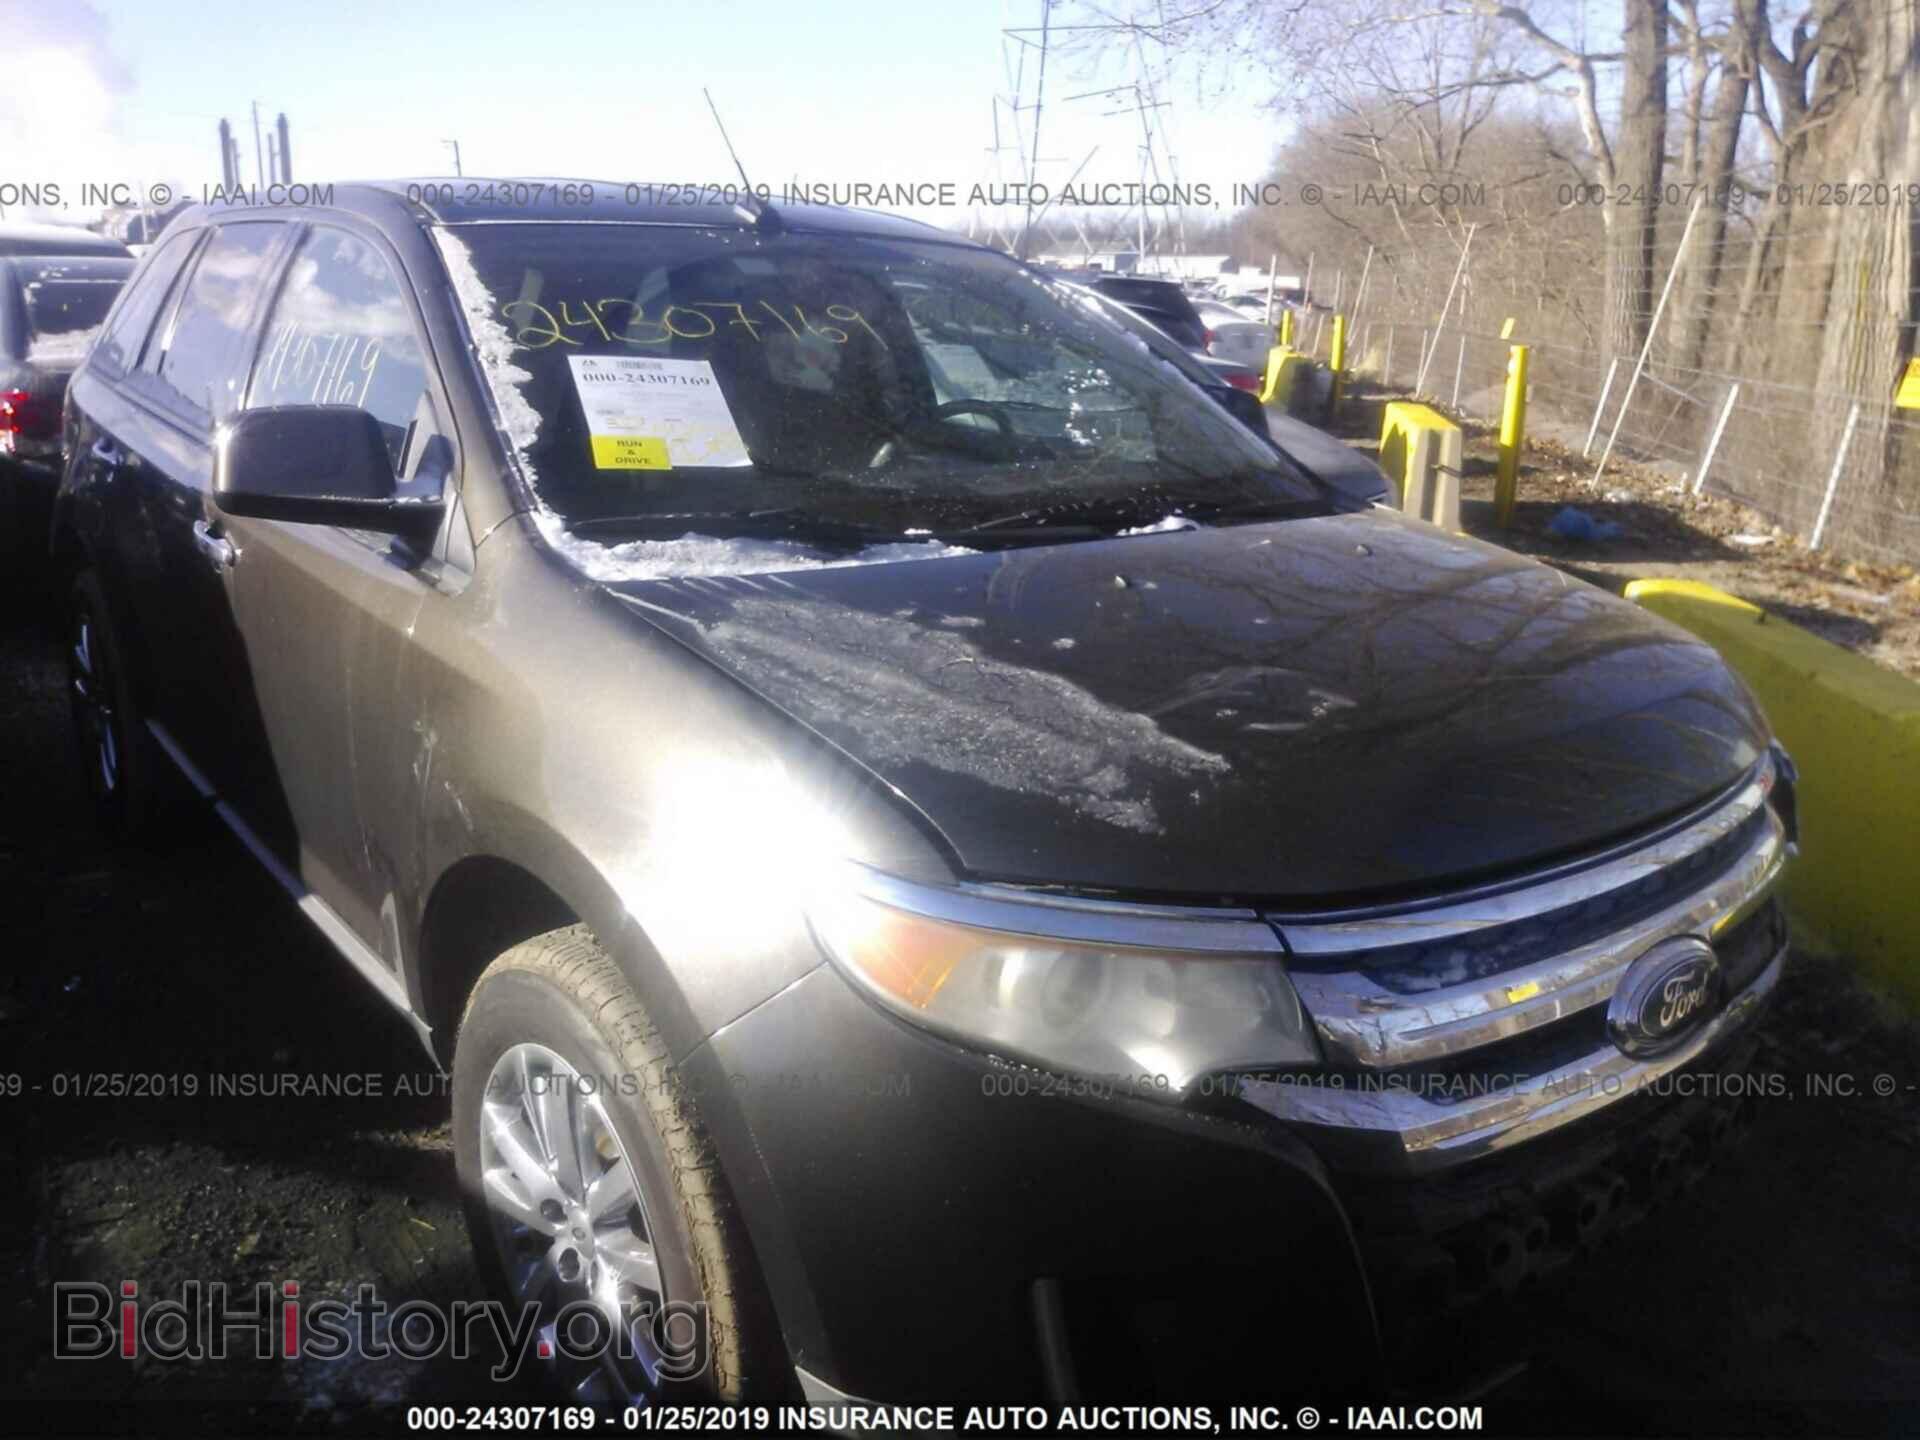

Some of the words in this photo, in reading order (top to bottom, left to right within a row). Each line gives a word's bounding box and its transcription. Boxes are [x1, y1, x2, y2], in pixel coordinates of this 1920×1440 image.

[502, 299, 889, 351] 24307169
[582, 372, 711, 386] 000-24307169
[616, 440, 643, 448] RUN
[614, 456, 652, 465] DRIVE
[1660, 969, 1709, 1028] Ford
